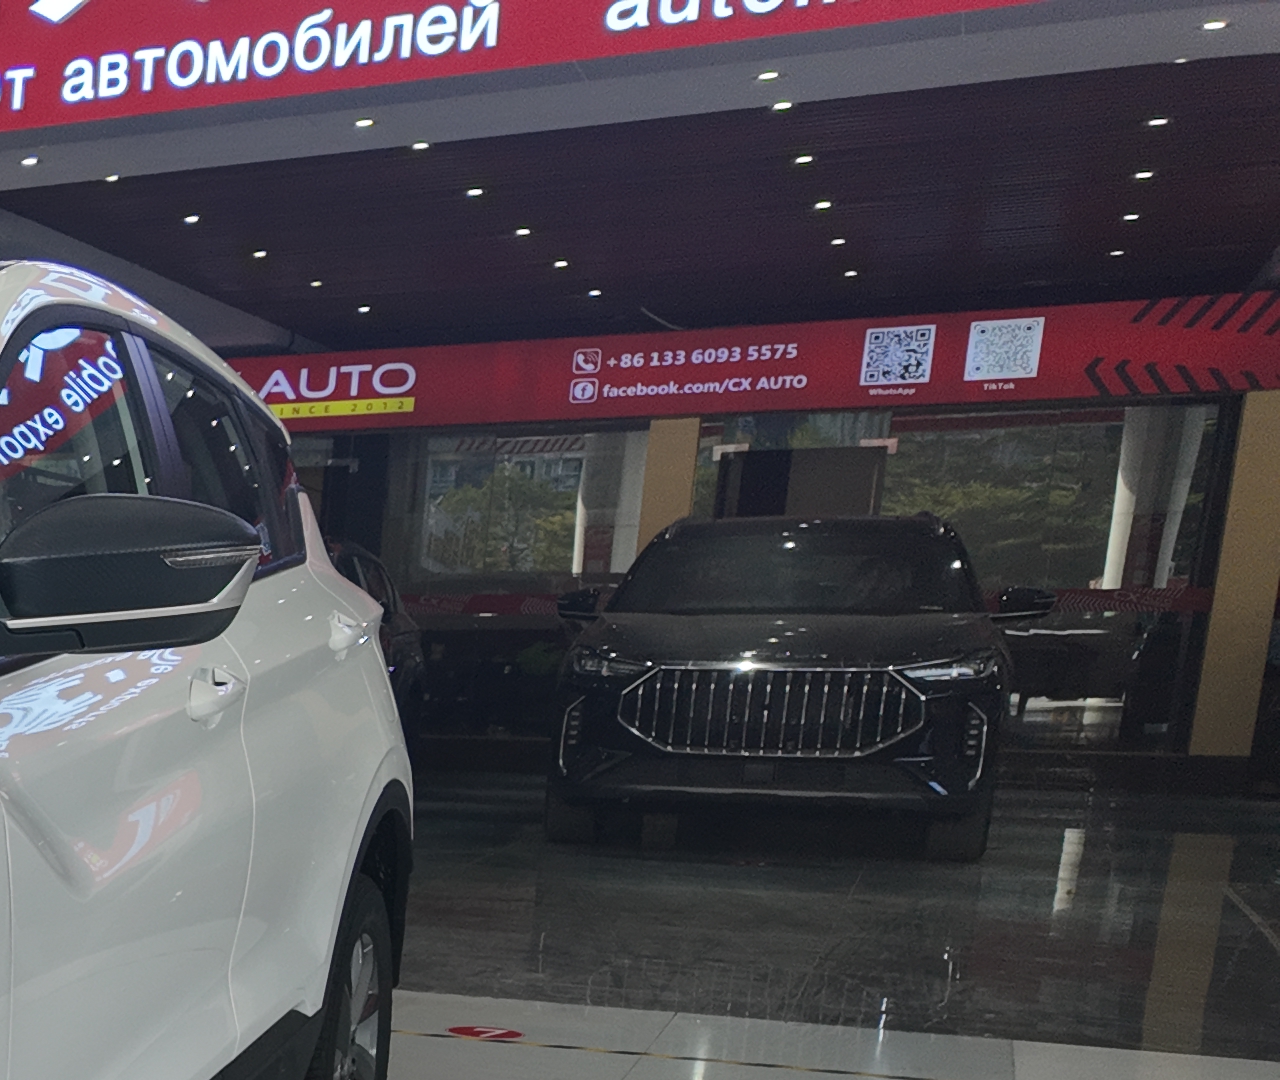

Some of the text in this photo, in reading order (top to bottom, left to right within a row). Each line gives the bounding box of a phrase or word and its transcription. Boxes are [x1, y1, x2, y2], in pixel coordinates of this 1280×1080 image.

[60, 1, 501, 104] автомобилей
[606, 343, 799, 370] +86 133 6093 5575
[258, 362, 417, 400] AUTO
[602, 374, 808, 399] facebook.com/CX AUTO
[868, 386, 916, 397] WhatsApp
[983, 382, 1016, 391] TikTok
[279, 401, 404, 416] INCE 2012
